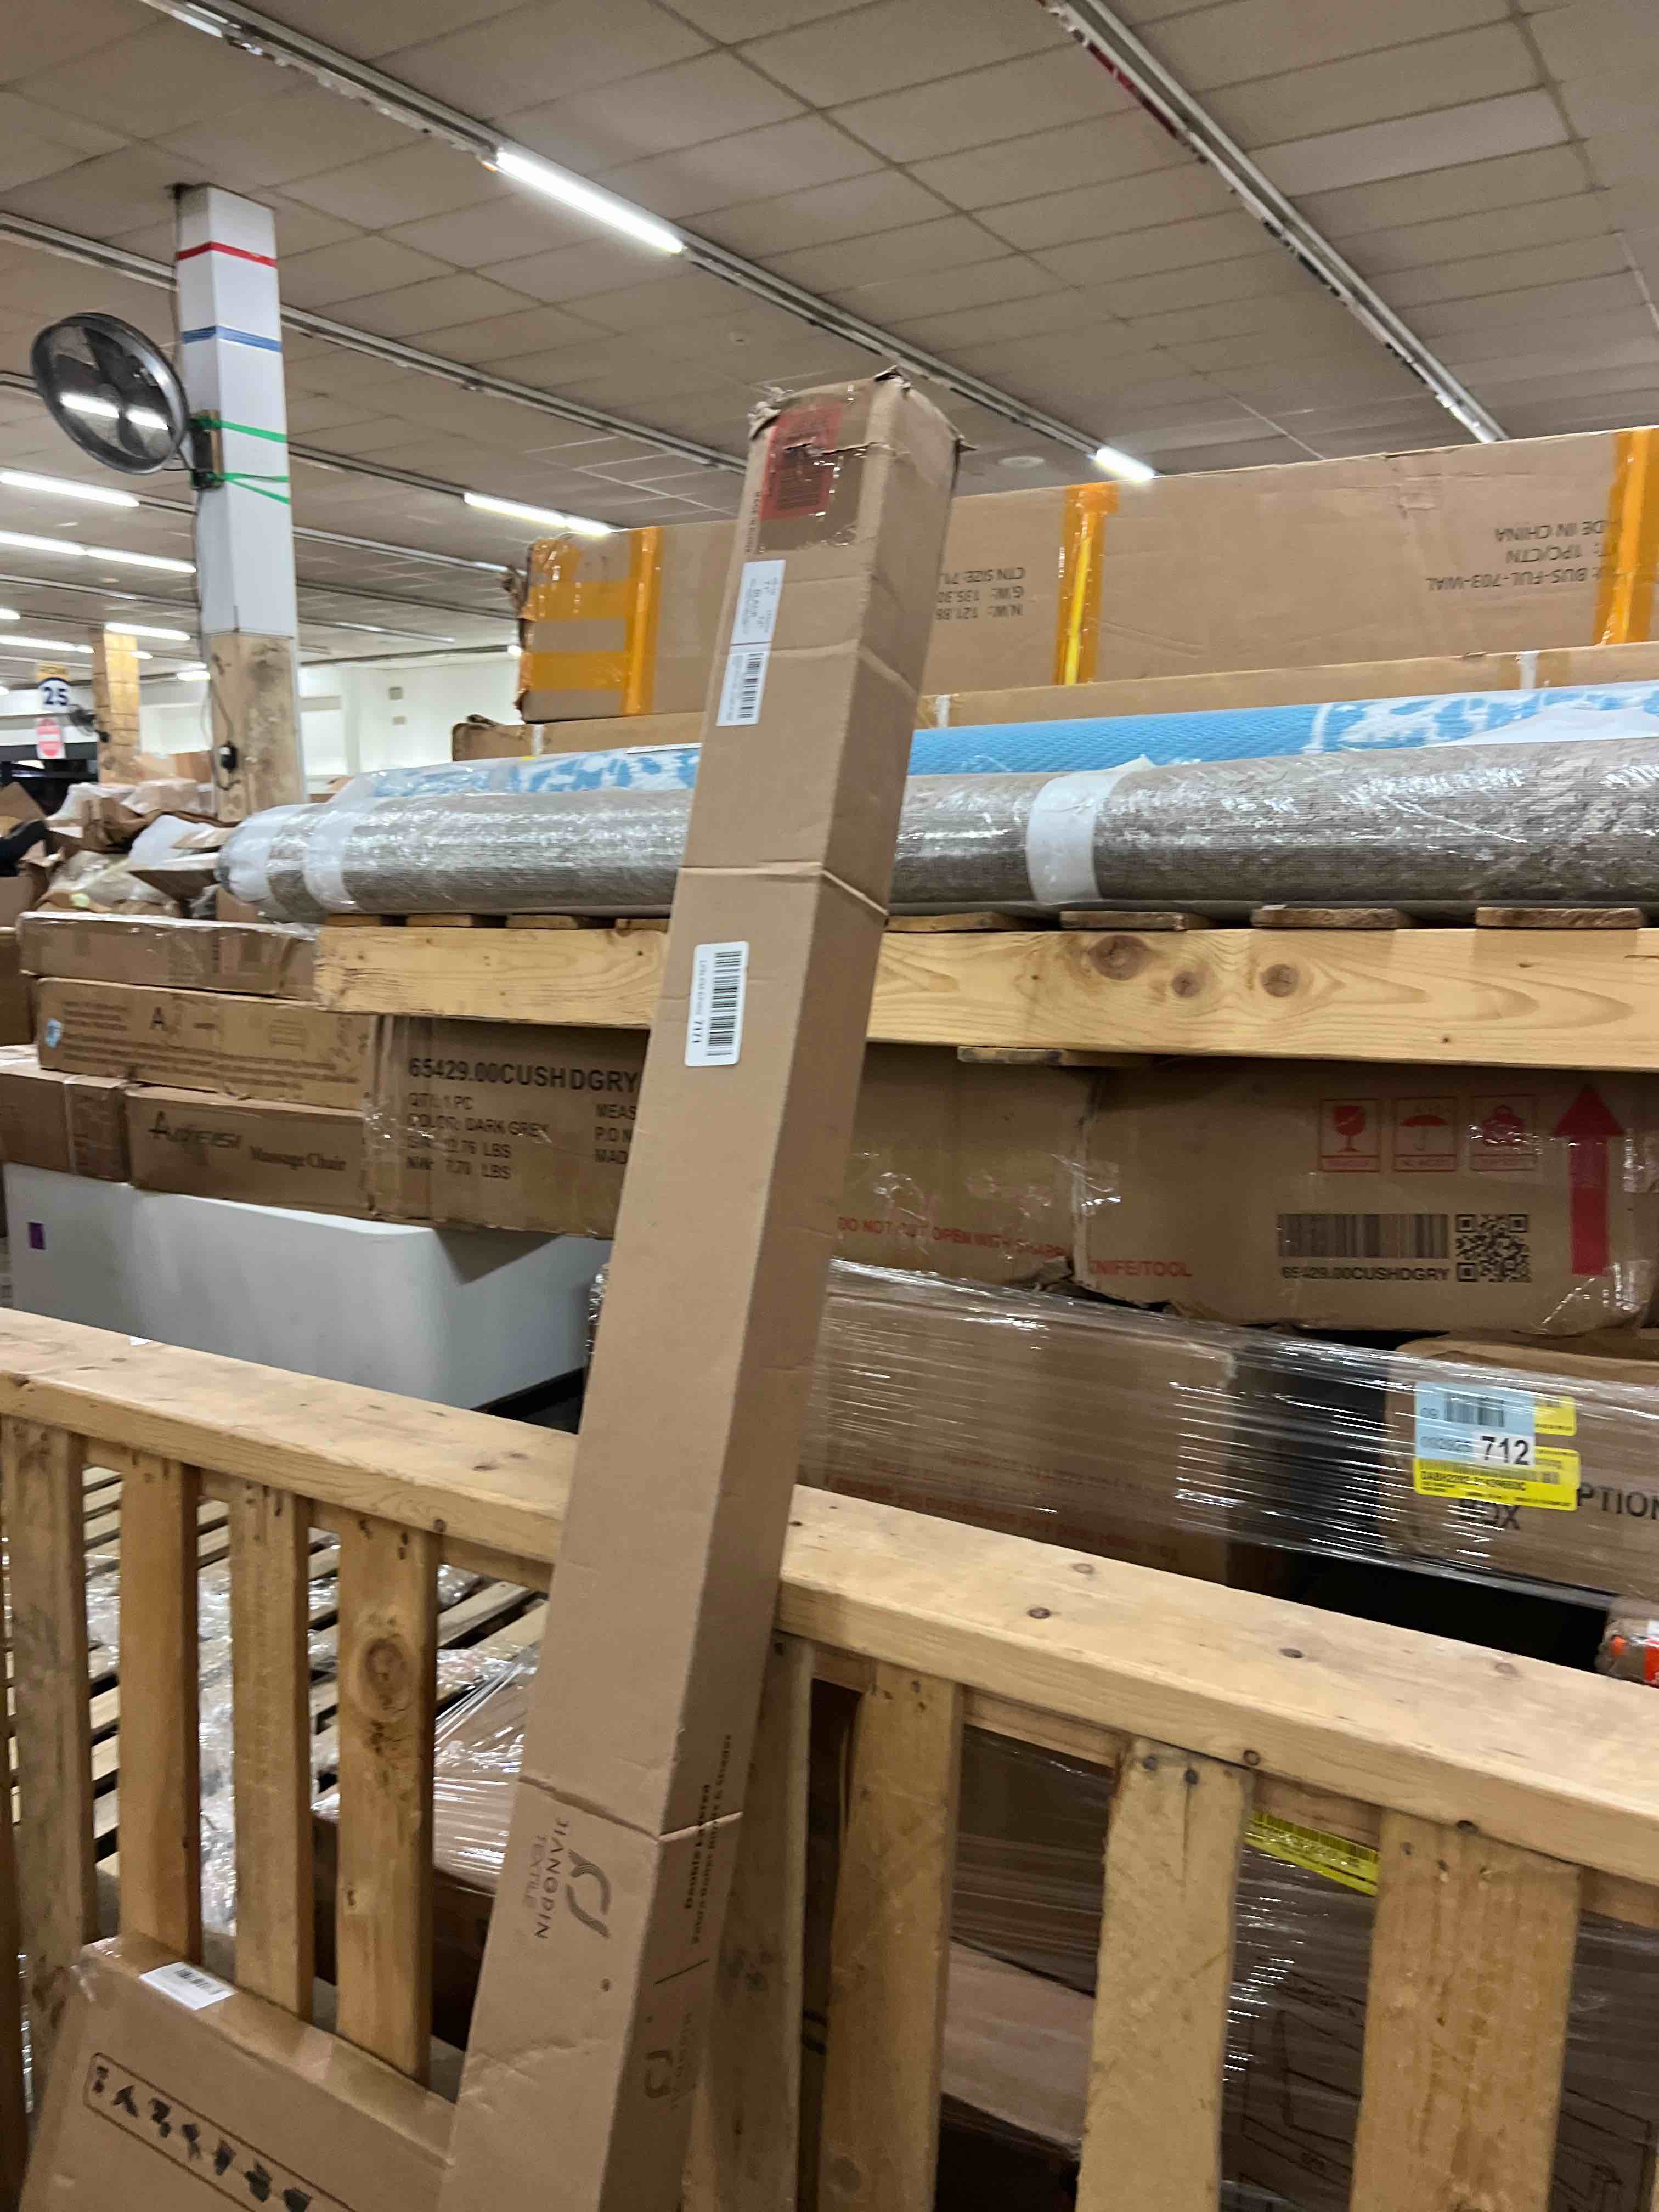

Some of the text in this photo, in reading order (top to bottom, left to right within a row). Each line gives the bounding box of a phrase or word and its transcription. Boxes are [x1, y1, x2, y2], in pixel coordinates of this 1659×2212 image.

[1494, 525, 1553, 542] CHINA
[43, 686, 69, 706] 25
[306, 1152, 347, 1172] Chair
[1481, 1435, 1530, 1466] 712
